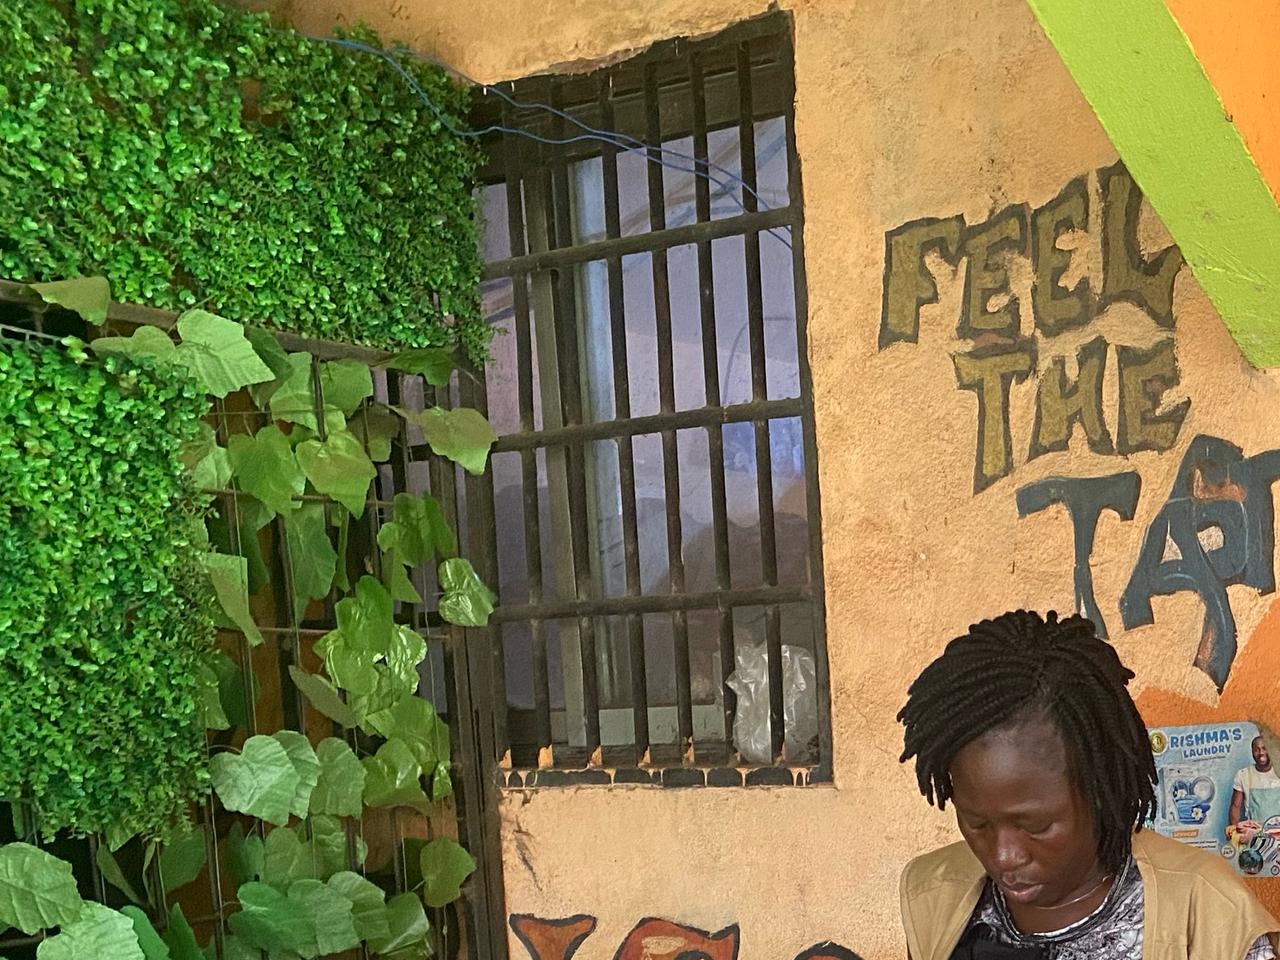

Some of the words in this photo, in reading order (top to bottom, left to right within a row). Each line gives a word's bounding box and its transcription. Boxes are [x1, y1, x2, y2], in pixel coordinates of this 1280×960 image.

[877, 161, 1185, 353] FEEL
[949, 334, 1191, 497] THE
[1170, 727, 1243, 750] RISHMA'S
[1183, 744, 1232, 760] LAUNDRY
